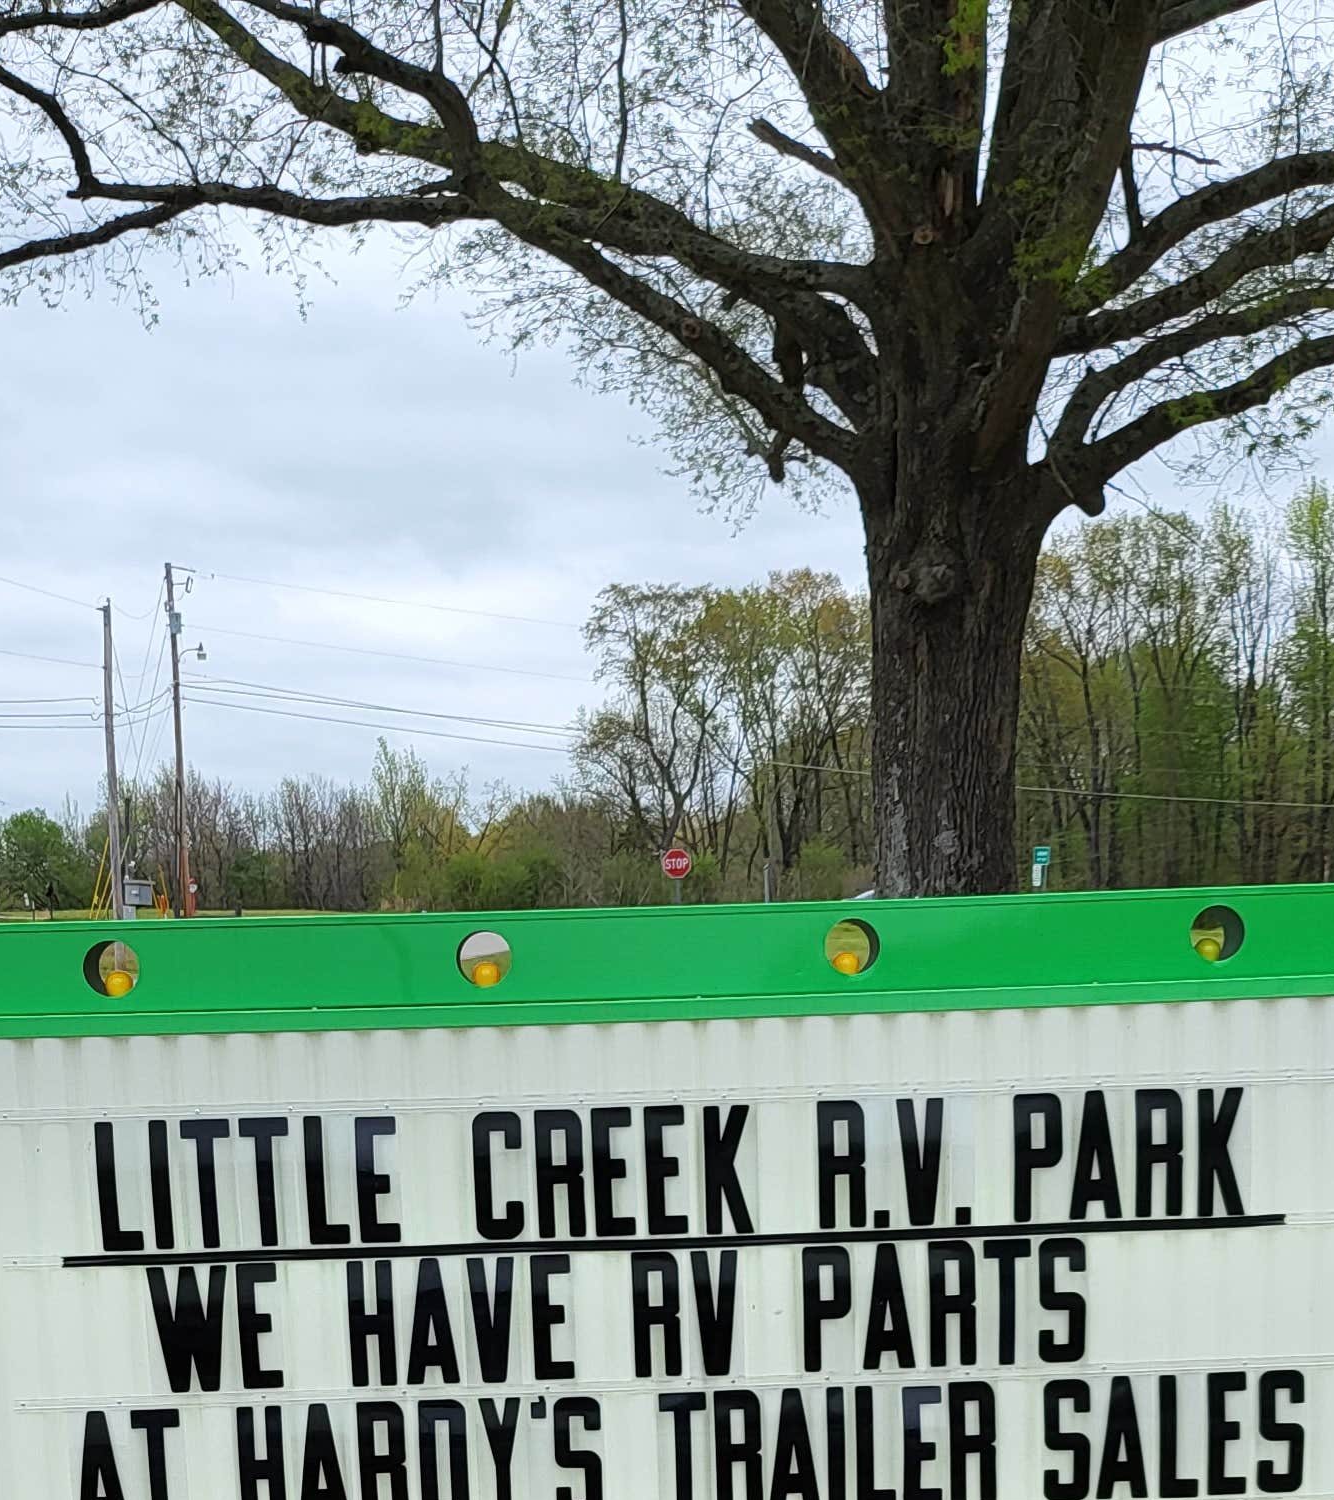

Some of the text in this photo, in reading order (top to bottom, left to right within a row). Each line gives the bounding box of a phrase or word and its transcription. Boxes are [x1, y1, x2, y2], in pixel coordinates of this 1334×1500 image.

[665, 858, 689, 870] STOP
[93, 1086, 1246, 1252] LITTLE CREEK R.V. PARK
[145, 1237, 1087, 1394] WE HAVE RV PARTS
